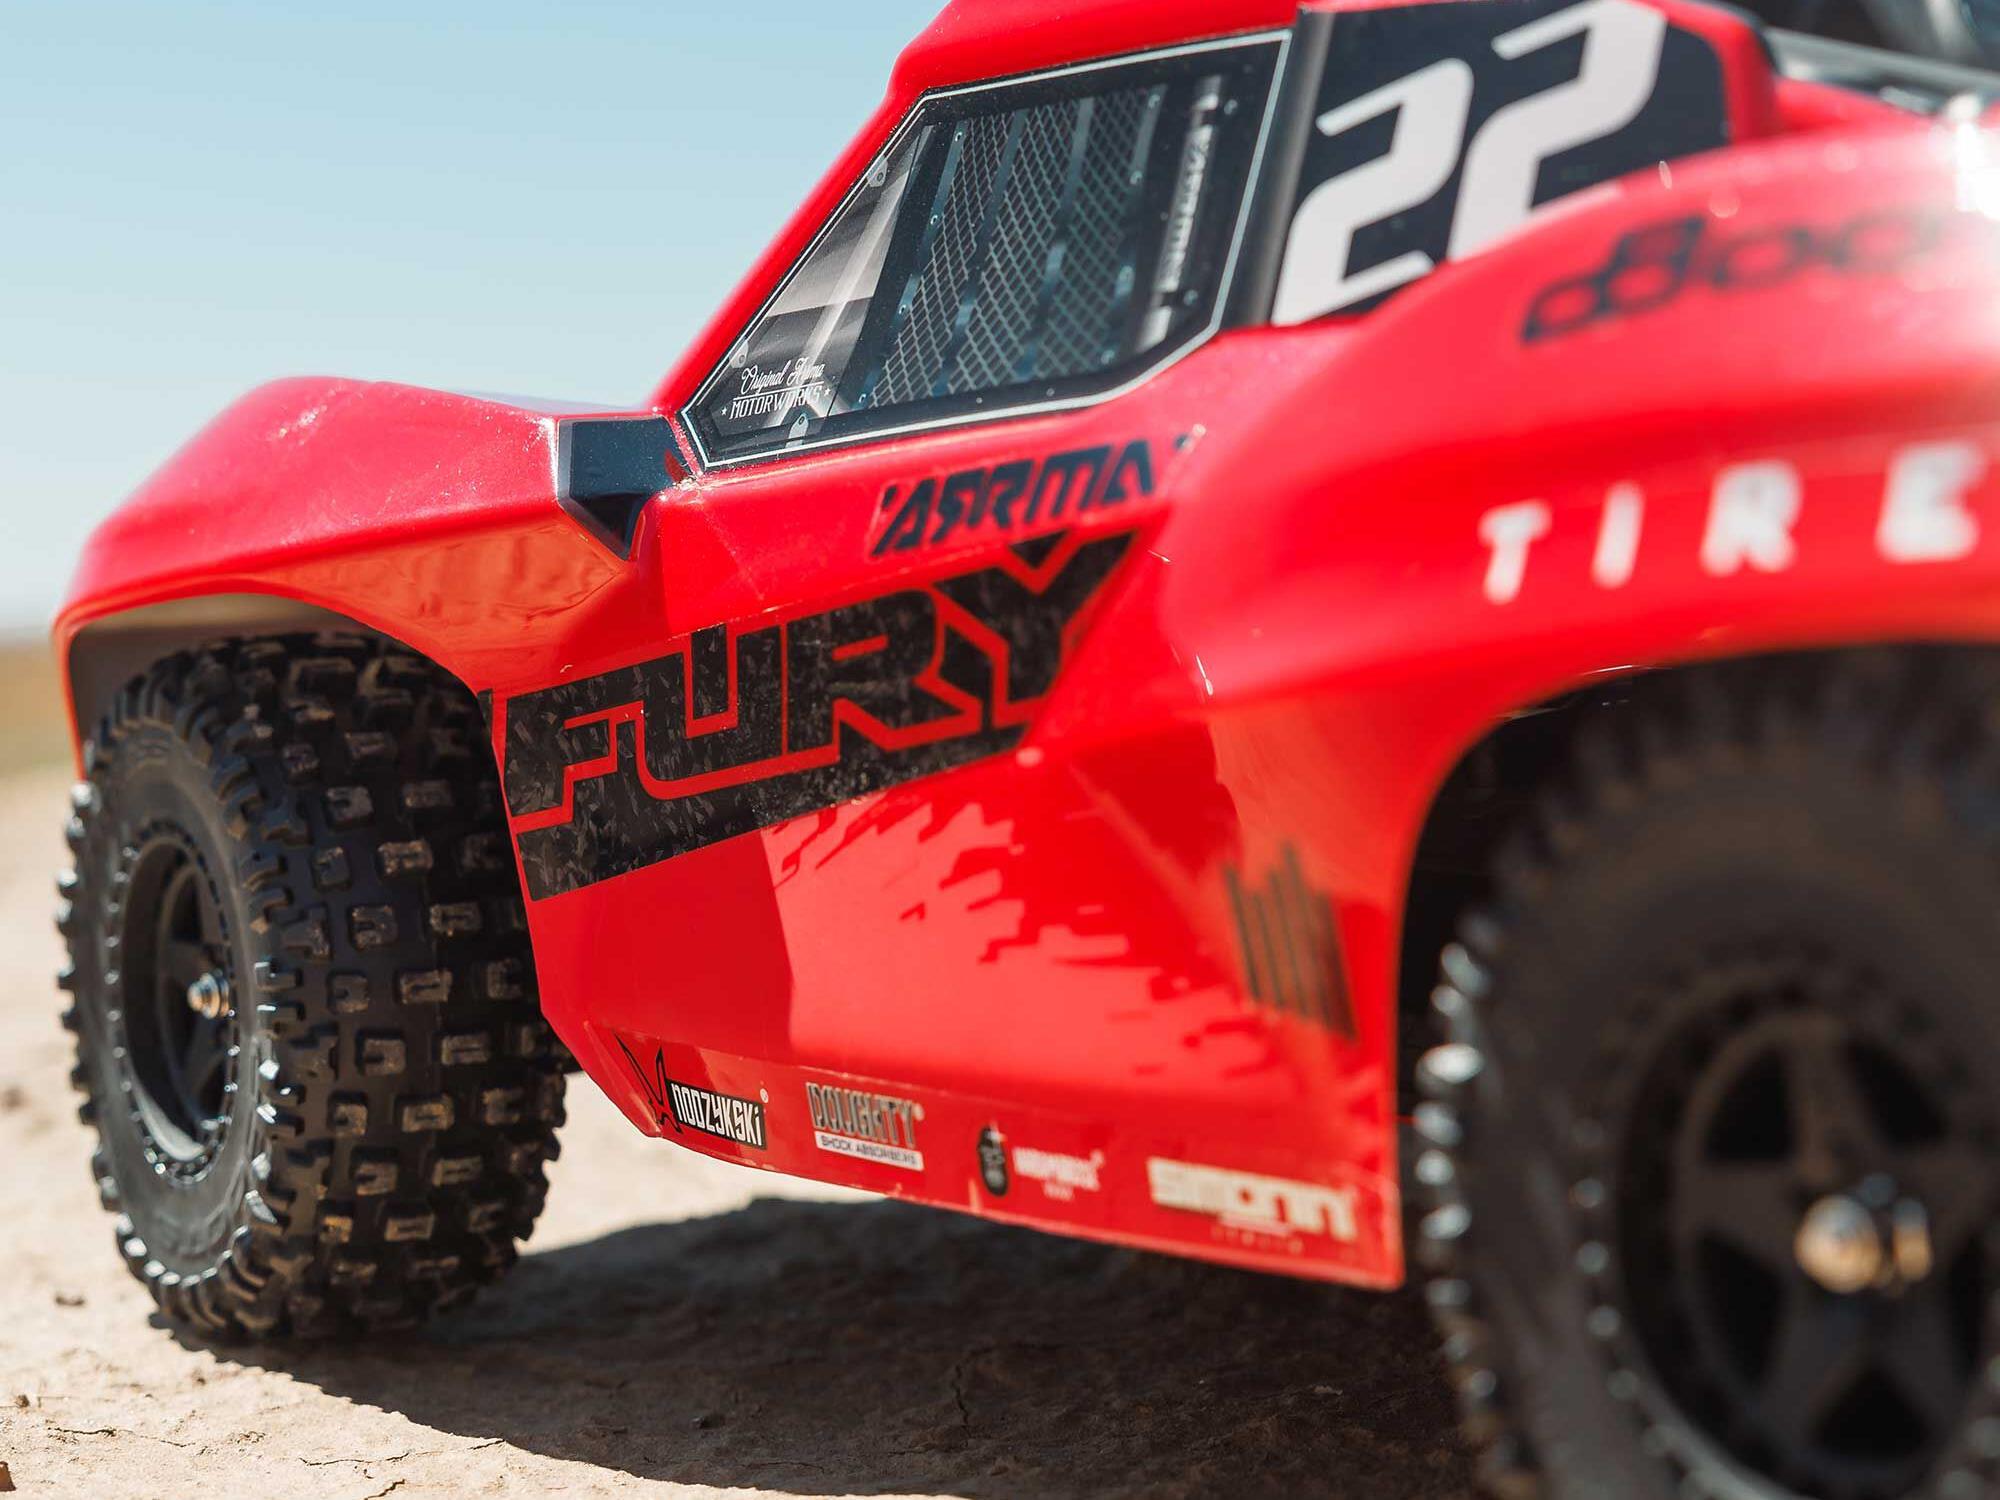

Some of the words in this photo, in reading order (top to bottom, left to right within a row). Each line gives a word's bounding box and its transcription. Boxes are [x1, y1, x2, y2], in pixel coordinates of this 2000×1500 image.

[1271, 0, 1668, 327] 22
[728, 384, 824, 420] MOTORWORKS
[740, 360, 792, 396] Original
[1479, 440, 1987, 605] TIRE
[505, 528, 1141, 822] FURY
